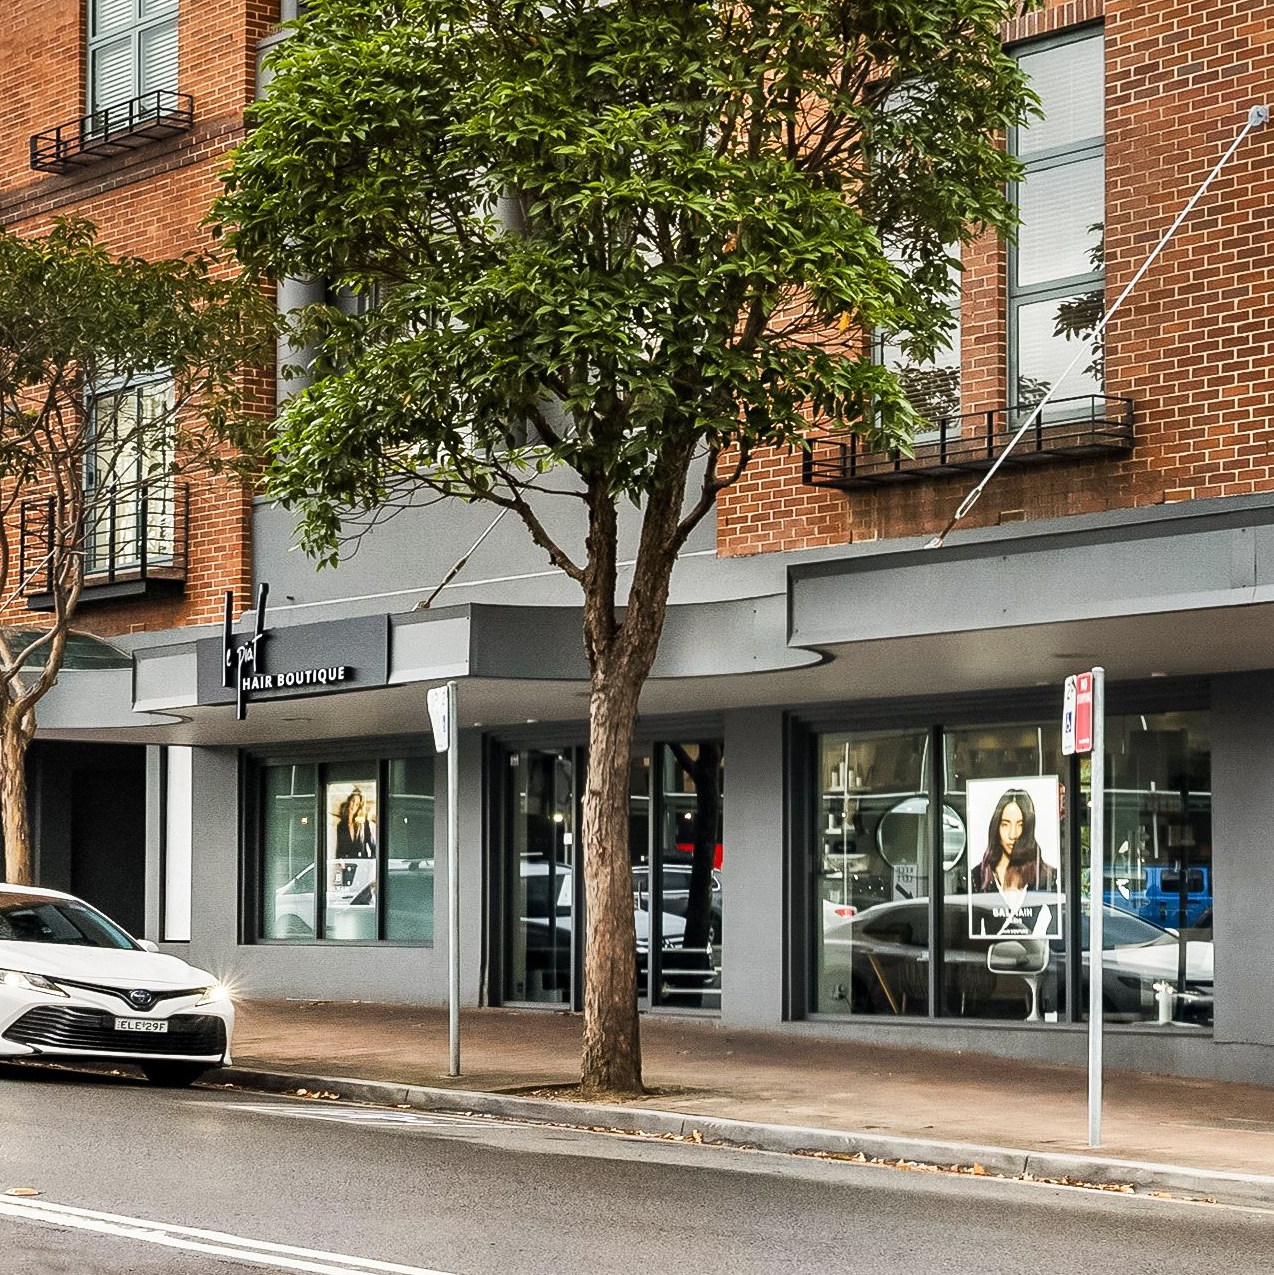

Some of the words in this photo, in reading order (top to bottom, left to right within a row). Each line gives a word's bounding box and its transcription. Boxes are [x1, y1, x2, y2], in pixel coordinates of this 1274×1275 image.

[242, 675, 273, 691] HAIR
[277, 666, 345, 687] BOUTIQUE
[992, 907, 1033, 918] BALAIN
